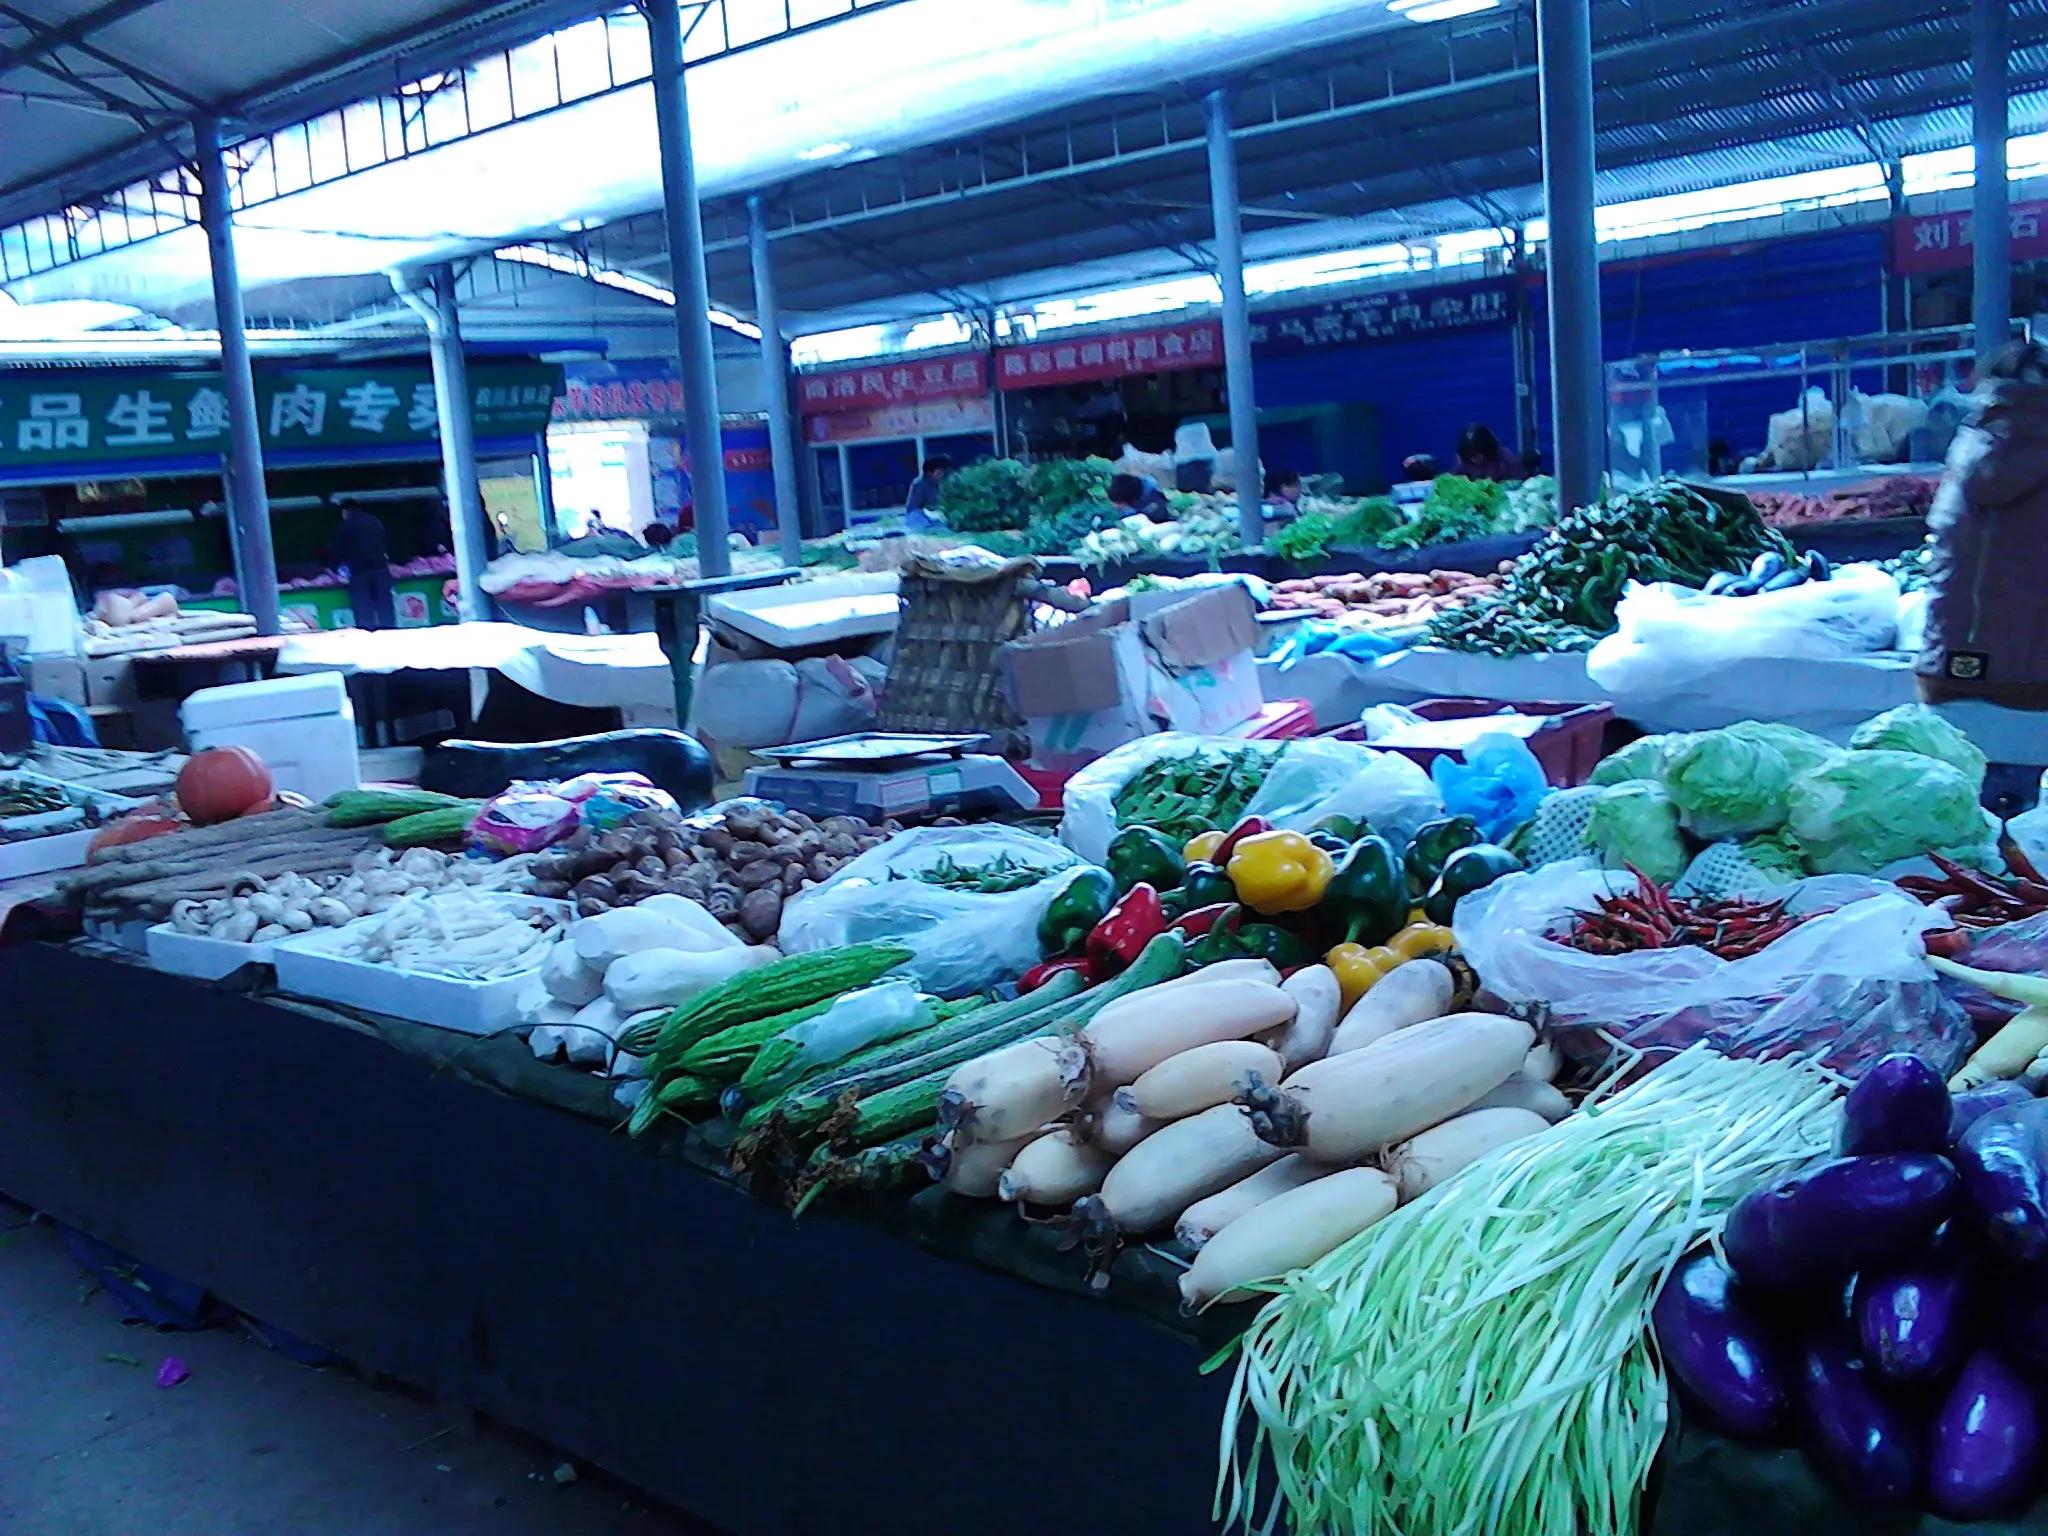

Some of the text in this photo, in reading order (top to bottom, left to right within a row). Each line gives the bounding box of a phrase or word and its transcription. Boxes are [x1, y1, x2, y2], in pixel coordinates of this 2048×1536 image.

[0, 380, 438, 451] 品生鲜肉专卖
